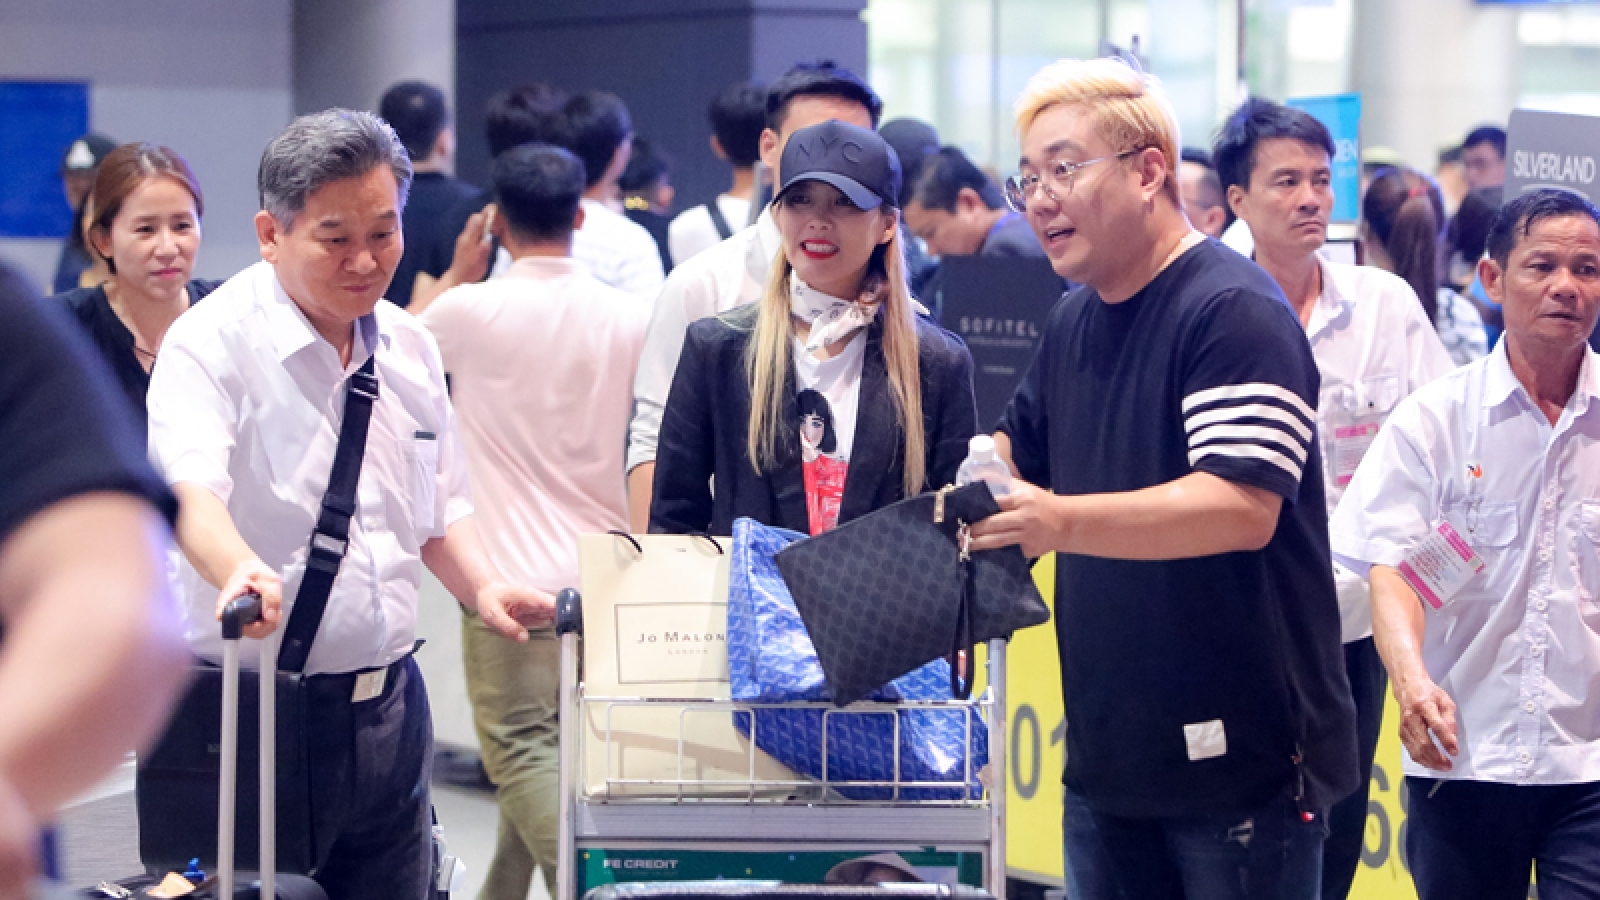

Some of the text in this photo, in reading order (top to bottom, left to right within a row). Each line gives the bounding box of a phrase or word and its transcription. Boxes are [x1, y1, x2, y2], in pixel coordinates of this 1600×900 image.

[796, 136, 863, 163] NYC
[1513, 149, 1596, 184] SILVERLAND
[960, 316, 1039, 338] SOFITEL
[603, 859, 679, 869] FE CREDIT
